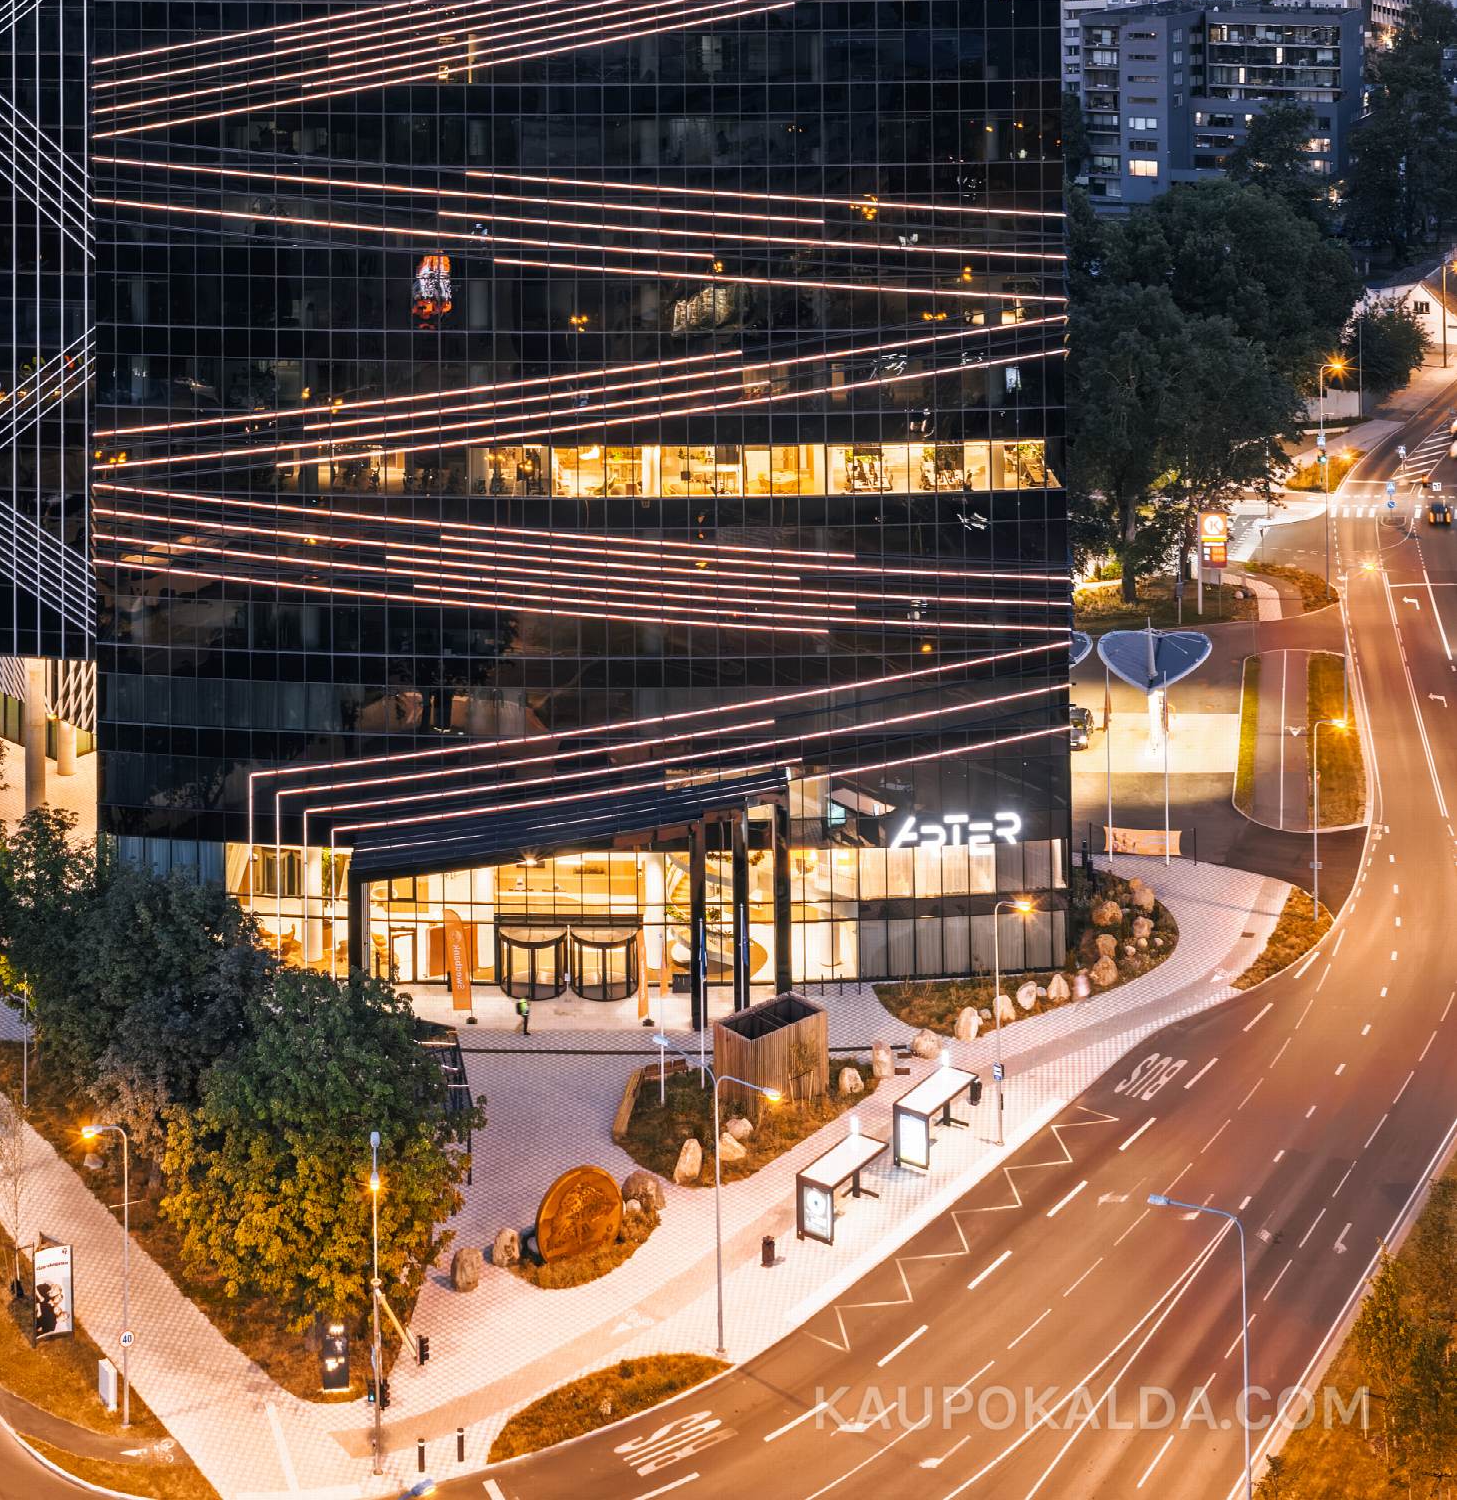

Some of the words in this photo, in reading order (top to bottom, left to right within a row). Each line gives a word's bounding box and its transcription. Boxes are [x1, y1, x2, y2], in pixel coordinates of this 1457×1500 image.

[890, 812, 1022, 857] ASTER
[1114, 1052, 1189, 1101] BUS
[122, 1334, 133, 1343] 40
[613, 1410, 739, 1477] BUS
